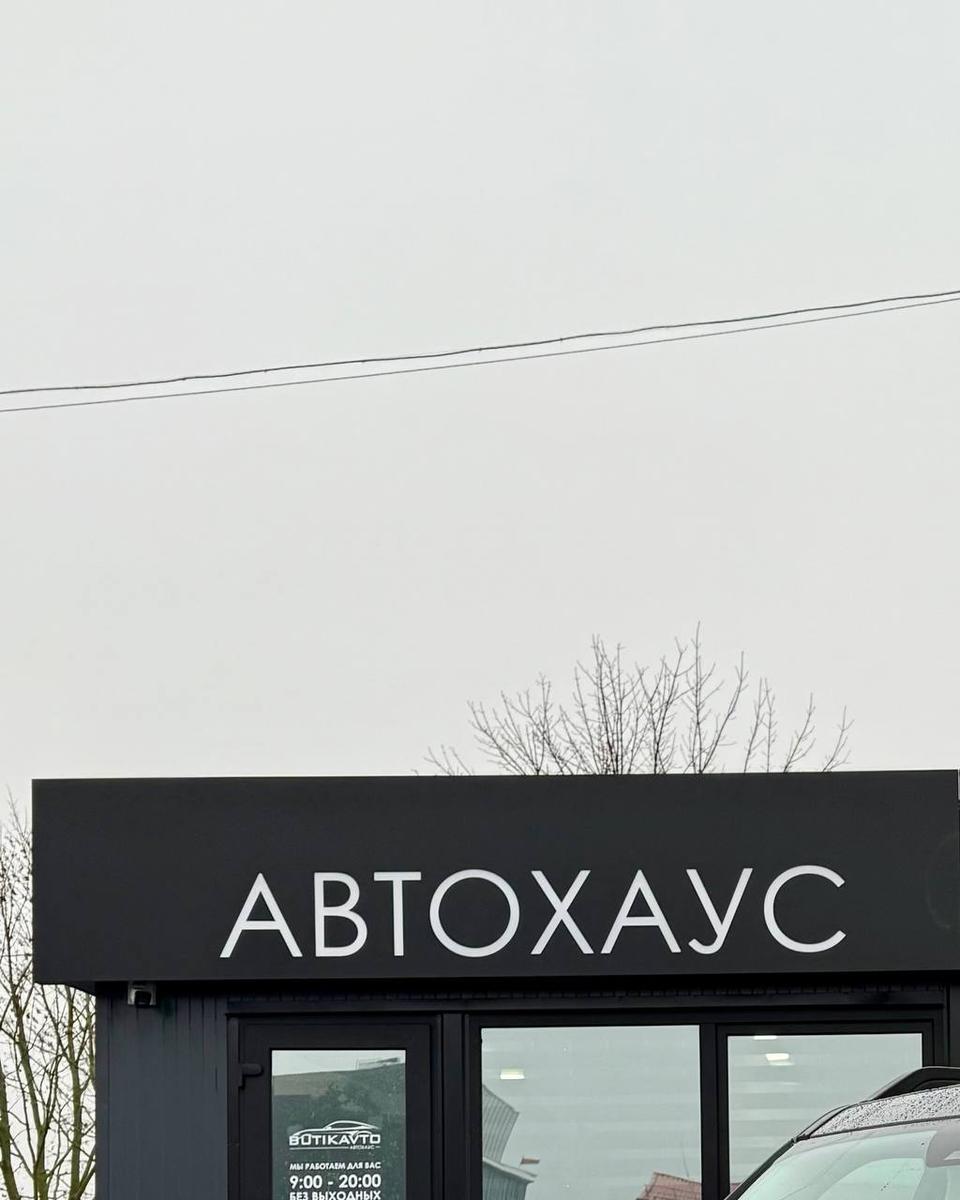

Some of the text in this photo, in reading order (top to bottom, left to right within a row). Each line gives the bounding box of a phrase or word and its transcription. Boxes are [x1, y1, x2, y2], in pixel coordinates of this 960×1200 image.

[220, 865, 847, 959] АВТОХАУС
[289, 1133, 381, 1146] BUTIKAVTO
[289, 1163, 304, 1171] МЫ
[305, 1162, 346, 1170] РАБОТАЕМ
[347, 1162, 363, 1170] ДЛЯ
[289, 1175, 323, 1189] 9:00
[339, 1174, 381, 1188] 20:00
